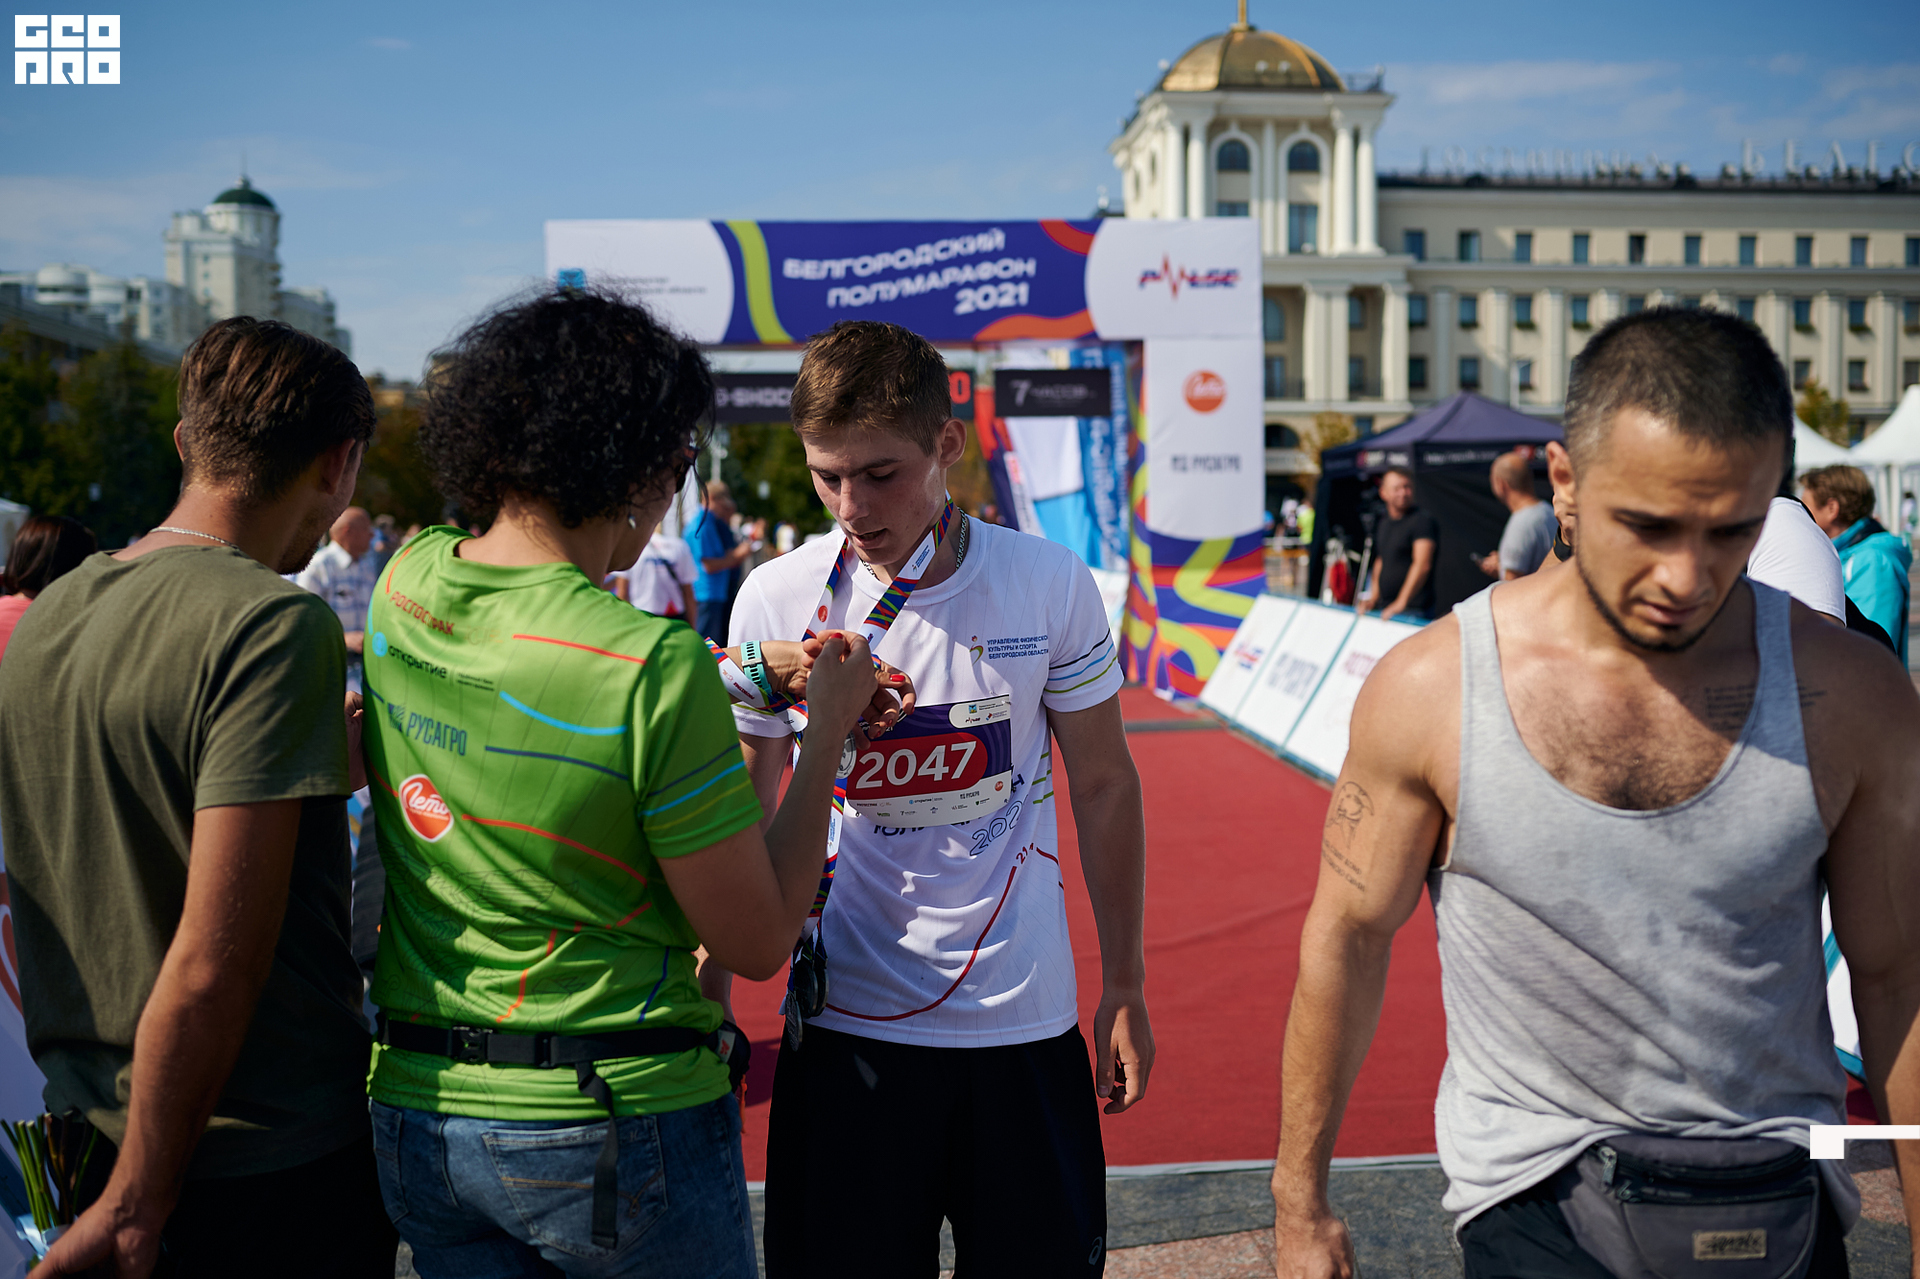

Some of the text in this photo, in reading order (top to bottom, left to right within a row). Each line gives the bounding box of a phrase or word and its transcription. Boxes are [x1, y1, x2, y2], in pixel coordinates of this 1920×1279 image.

[783, 227, 1006, 280] БЕЛГОРОДСКИЙ
[827, 258, 1037, 309] ПОЛУМАРАФОН
[953, 282, 1030, 315] 2021
[989, 651, 1027, 659] БЕЛГОРОДСКОЙ
[1020, 635, 1049, 643] ФИЗИЧЕСКО
[406, 712, 467, 756] РУСАГРО
[855, 741, 977, 789] 2047
